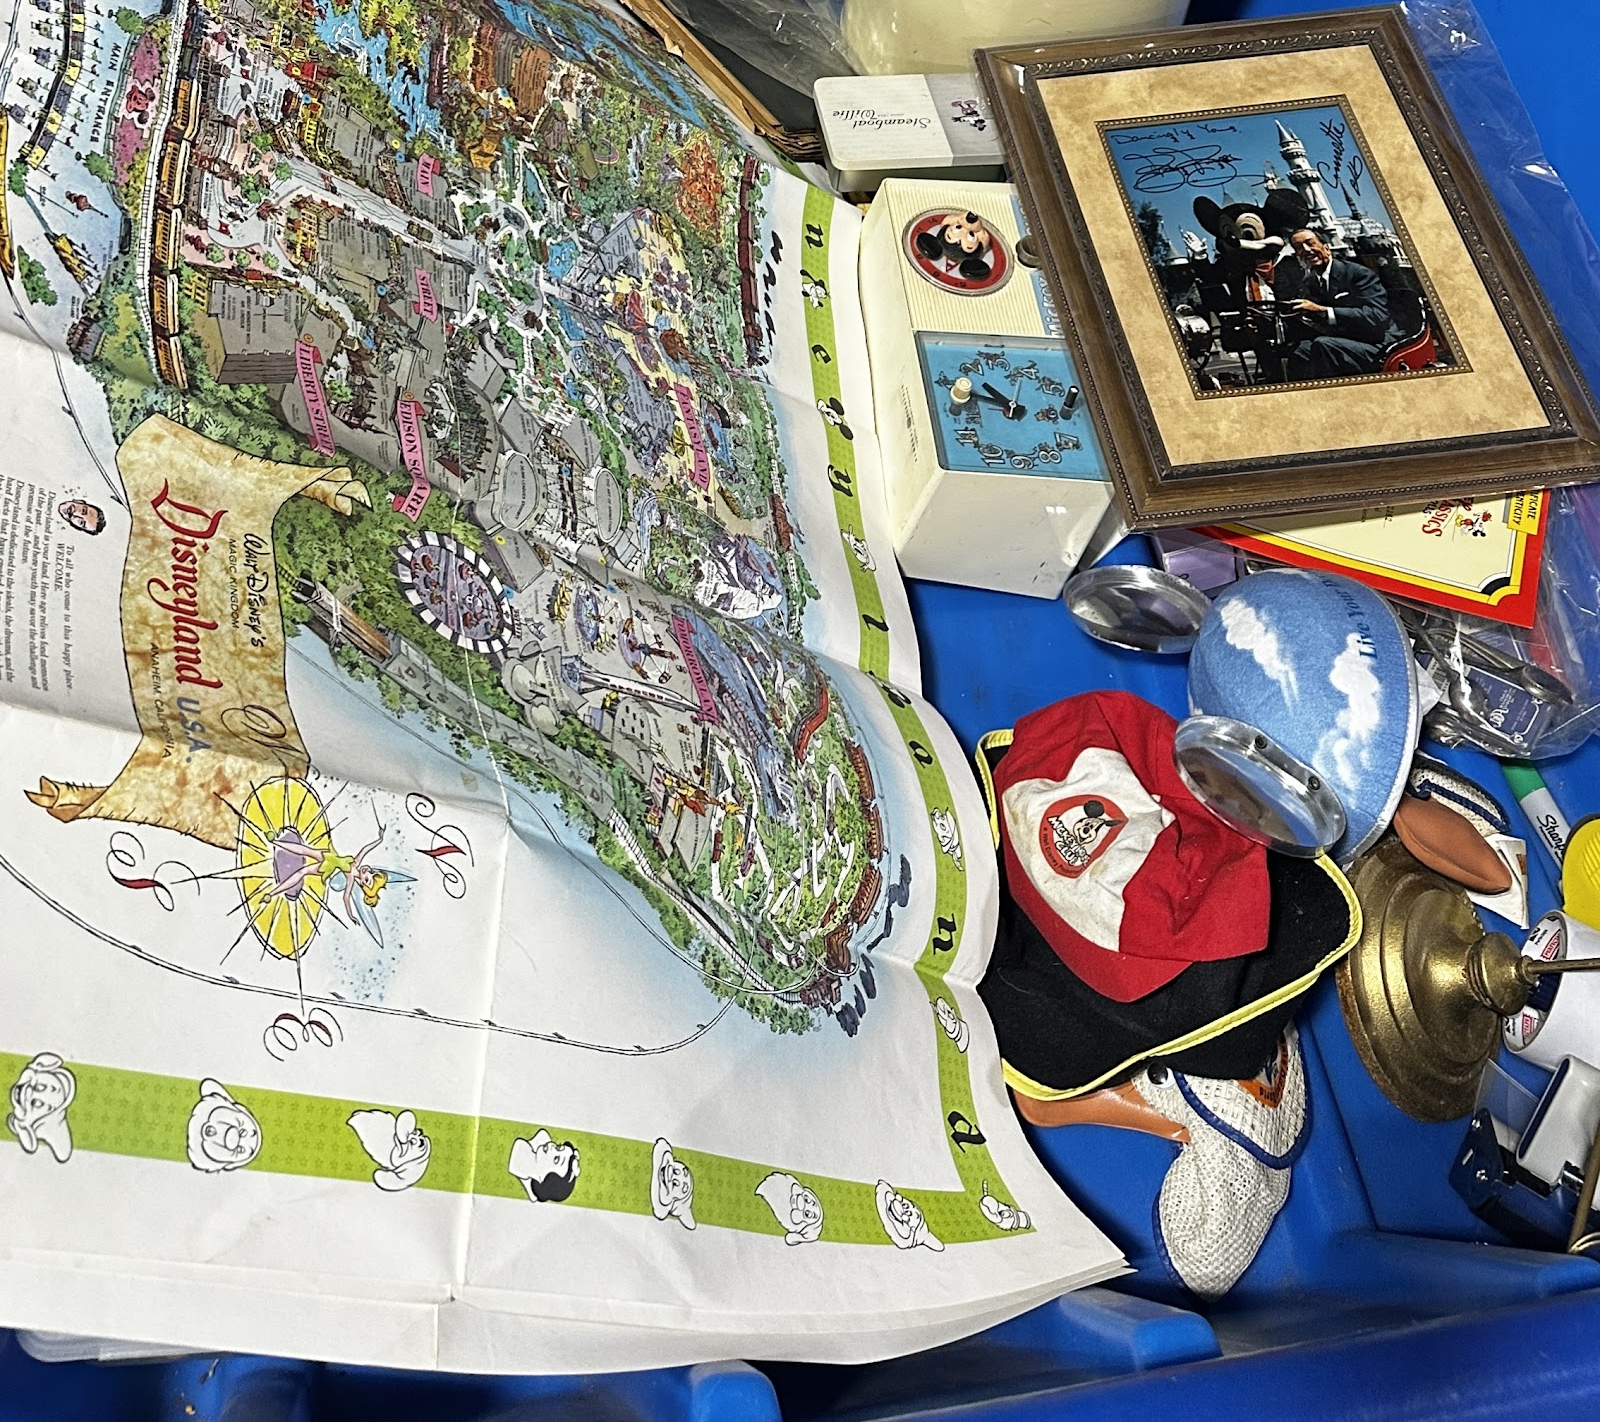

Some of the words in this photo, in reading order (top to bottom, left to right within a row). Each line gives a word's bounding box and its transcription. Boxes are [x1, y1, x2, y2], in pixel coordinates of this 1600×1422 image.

[109, 43, 123, 72] MAIN
[90, 79, 114, 144] ENTRANCE
[832, 109, 877, 120] Willie
[852, 118, 930, 129] Steamboat
[418, 155, 434, 190] MAIN
[418, 274, 437, 316] STREET
[297, 346, 320, 404] LIBERTY
[310, 406, 333, 453] STREET
[399, 402, 417, 453] EDISON
[677, 387, 708, 487] FANTASYLAND
[26, 483, 35, 514] promise
[38, 487, 46, 496] of
[404, 458, 428, 515] SQUARE
[11, 480, 24, 523] Disneyland
[37, 496, 45, 508] the
[44, 491, 56, 533] Disneyland
[23, 524, 31, 537] the
[25, 515, 32, 524] of
[7, 531, 17, 567] dedicated
[32, 535, 40, 549] and
[42, 542, 50, 559] your
[66, 545, 74, 554] To
[32, 550, 40, 567] here
[54, 542, 64, 591] WELCOME.
[65, 557, 73, 568] all
[228, 538, 238, 573] MAGIC
[7, 568, 14, 576] to
[29, 568, 39, 589] youth
[41, 560, 49, 579] land.
[64, 572, 72, 588] who
[6, 577, 15, 589] the
[40, 581, 48, 600] Here
[146, 478, 228, 689] Disneyland
[28, 590, 37, 605] may
[38, 601, 47, 613] age
[229, 576, 239, 628] KINGDOM
[1337, 585, 1364, 619] Your
[5, 615, 13, 626] the
[39, 615, 47, 639] relives
[64, 624, 72, 639] this
[29, 628, 37, 640] the
[1354, 620, 1377, 661] Live
[39, 641, 49, 657] fond
[62, 642, 72, 666] happy
[5, 657, 13, 671] and
[676, 618, 721, 723] TOMORROWLAND
[152, 698, 174, 758] CALIFORNIA
[176, 696, 211, 763] U.S.A.
[1048, 816, 1078, 848] MICKEY
[1054, 840, 1077, 866] CLUB
